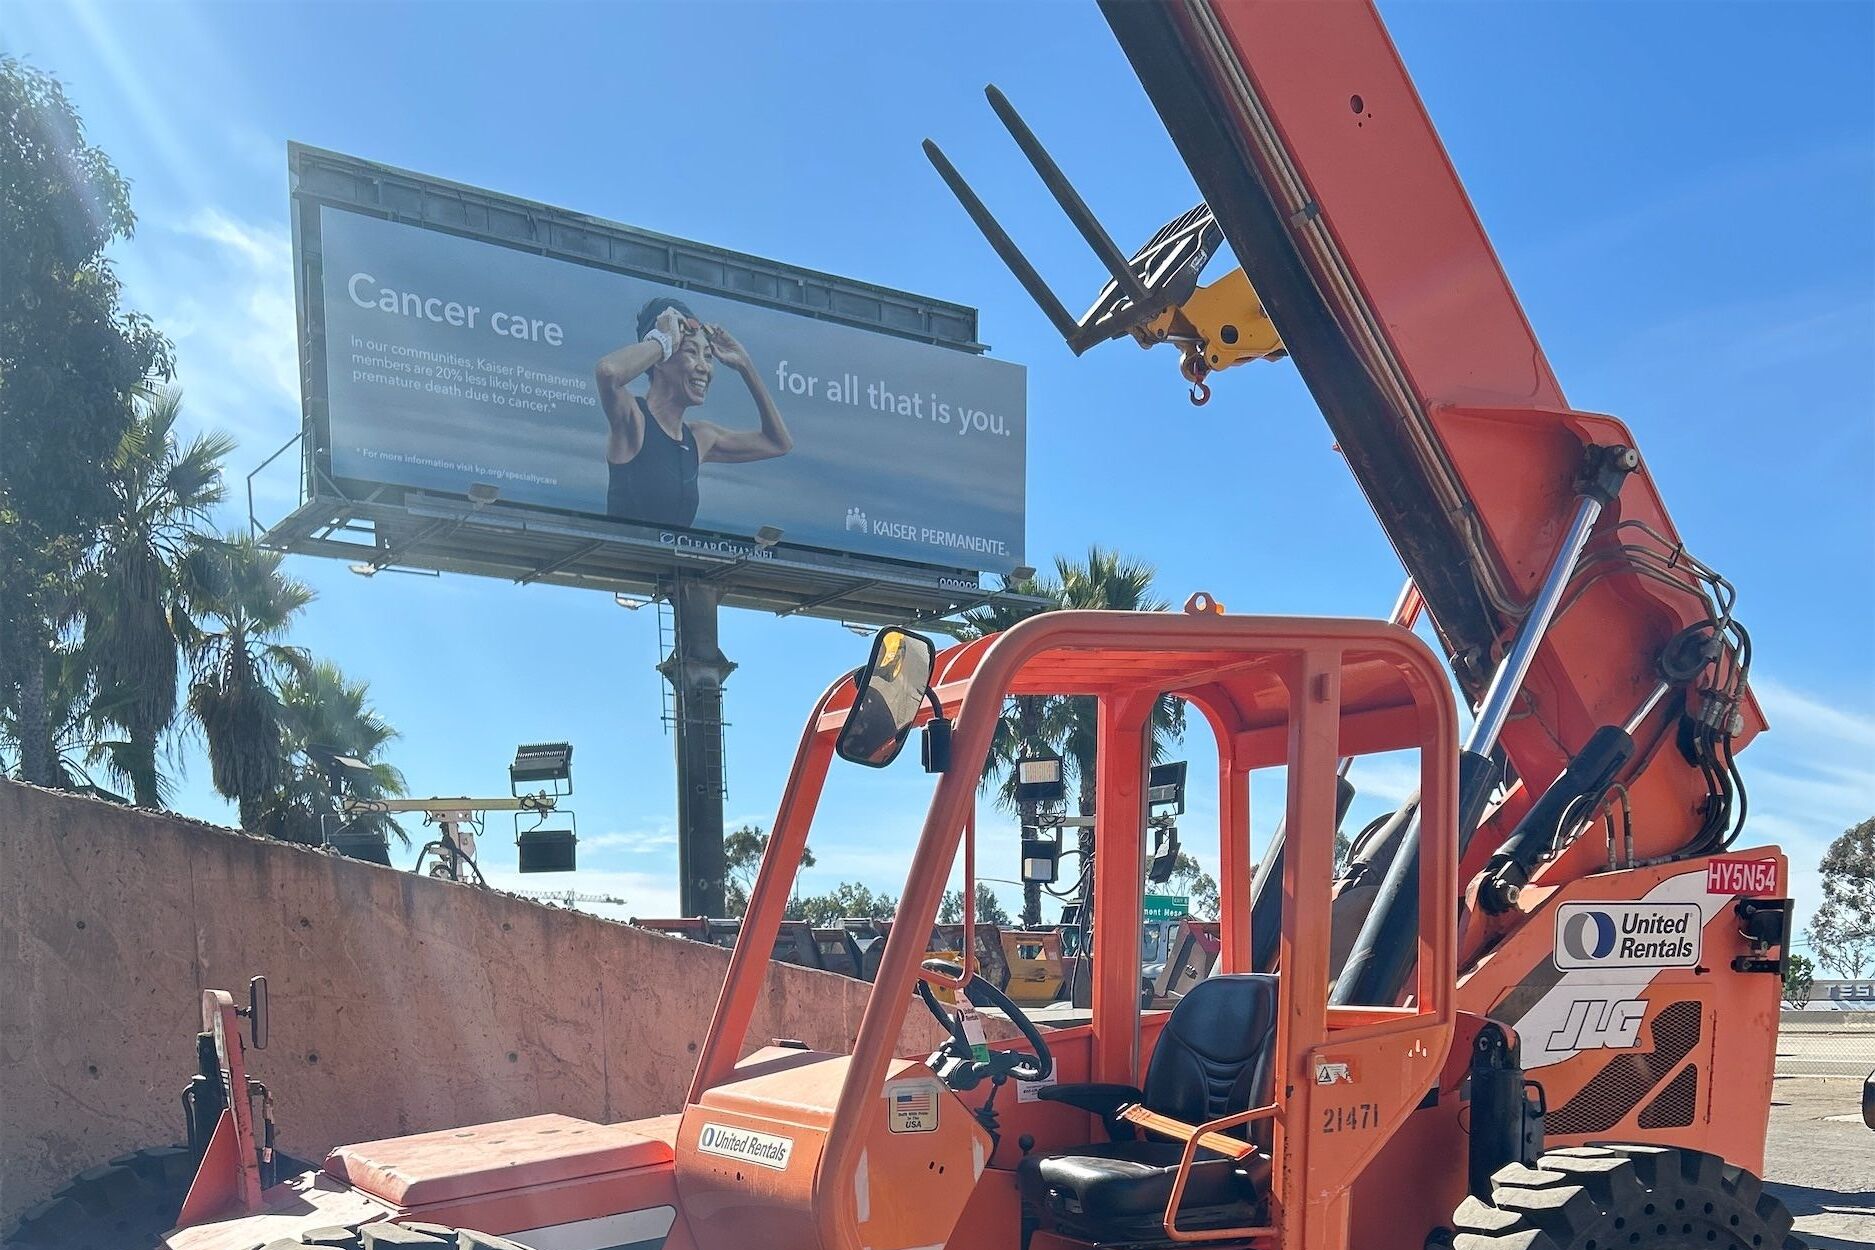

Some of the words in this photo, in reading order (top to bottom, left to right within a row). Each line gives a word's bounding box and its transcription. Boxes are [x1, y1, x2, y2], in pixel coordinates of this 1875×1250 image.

[348, 272, 480, 328] Cancer
[491, 312, 564, 346] care
[351, 334, 363, 349] In
[366, 340, 388, 352] our
[391, 345, 474, 369] communities,
[477, 358, 513, 375] Kaiser
[517, 366, 586, 389] Permanente
[352, 353, 411, 373] members
[414, 365, 433, 376] are
[436, 366, 463, 382] 20%
[466, 371, 487, 386] less
[489, 376, 518, 394] likely
[521, 383, 532, 394] to
[535, 388, 596, 406] experience
[353, 370, 421, 390] premature
[425, 380, 461, 397] death
[465, 387, 489, 402] due
[492, 392, 505, 405] to
[776, 360, 818, 397] for
[826, 373, 858, 405] all
[867, 381, 923, 419] that
[931, 393, 950, 424] is
[958, 407, 1010, 436] you.
[363, 448, 378, 458] For
[380, 452, 402, 461] more
[404, 454, 454, 470] information
[456, 463, 473, 472] visit
[873, 519, 917, 541] KAISER
[921, 528, 1006, 556] PERMANENTE
[1708, 862, 1776, 892] HY5N54
[1622, 913, 1689, 935] United
[1619, 937, 1693, 959] Rentals
[1824, 984, 1875, 1000] TES
[1545, 999, 1650, 1052] JLG
[905, 1120, 922, 1129] USA
[1323, 1103, 1378, 1134] 21471
[715, 1130, 750, 1153] United
[747, 1136, 786, 1161] Rentals
